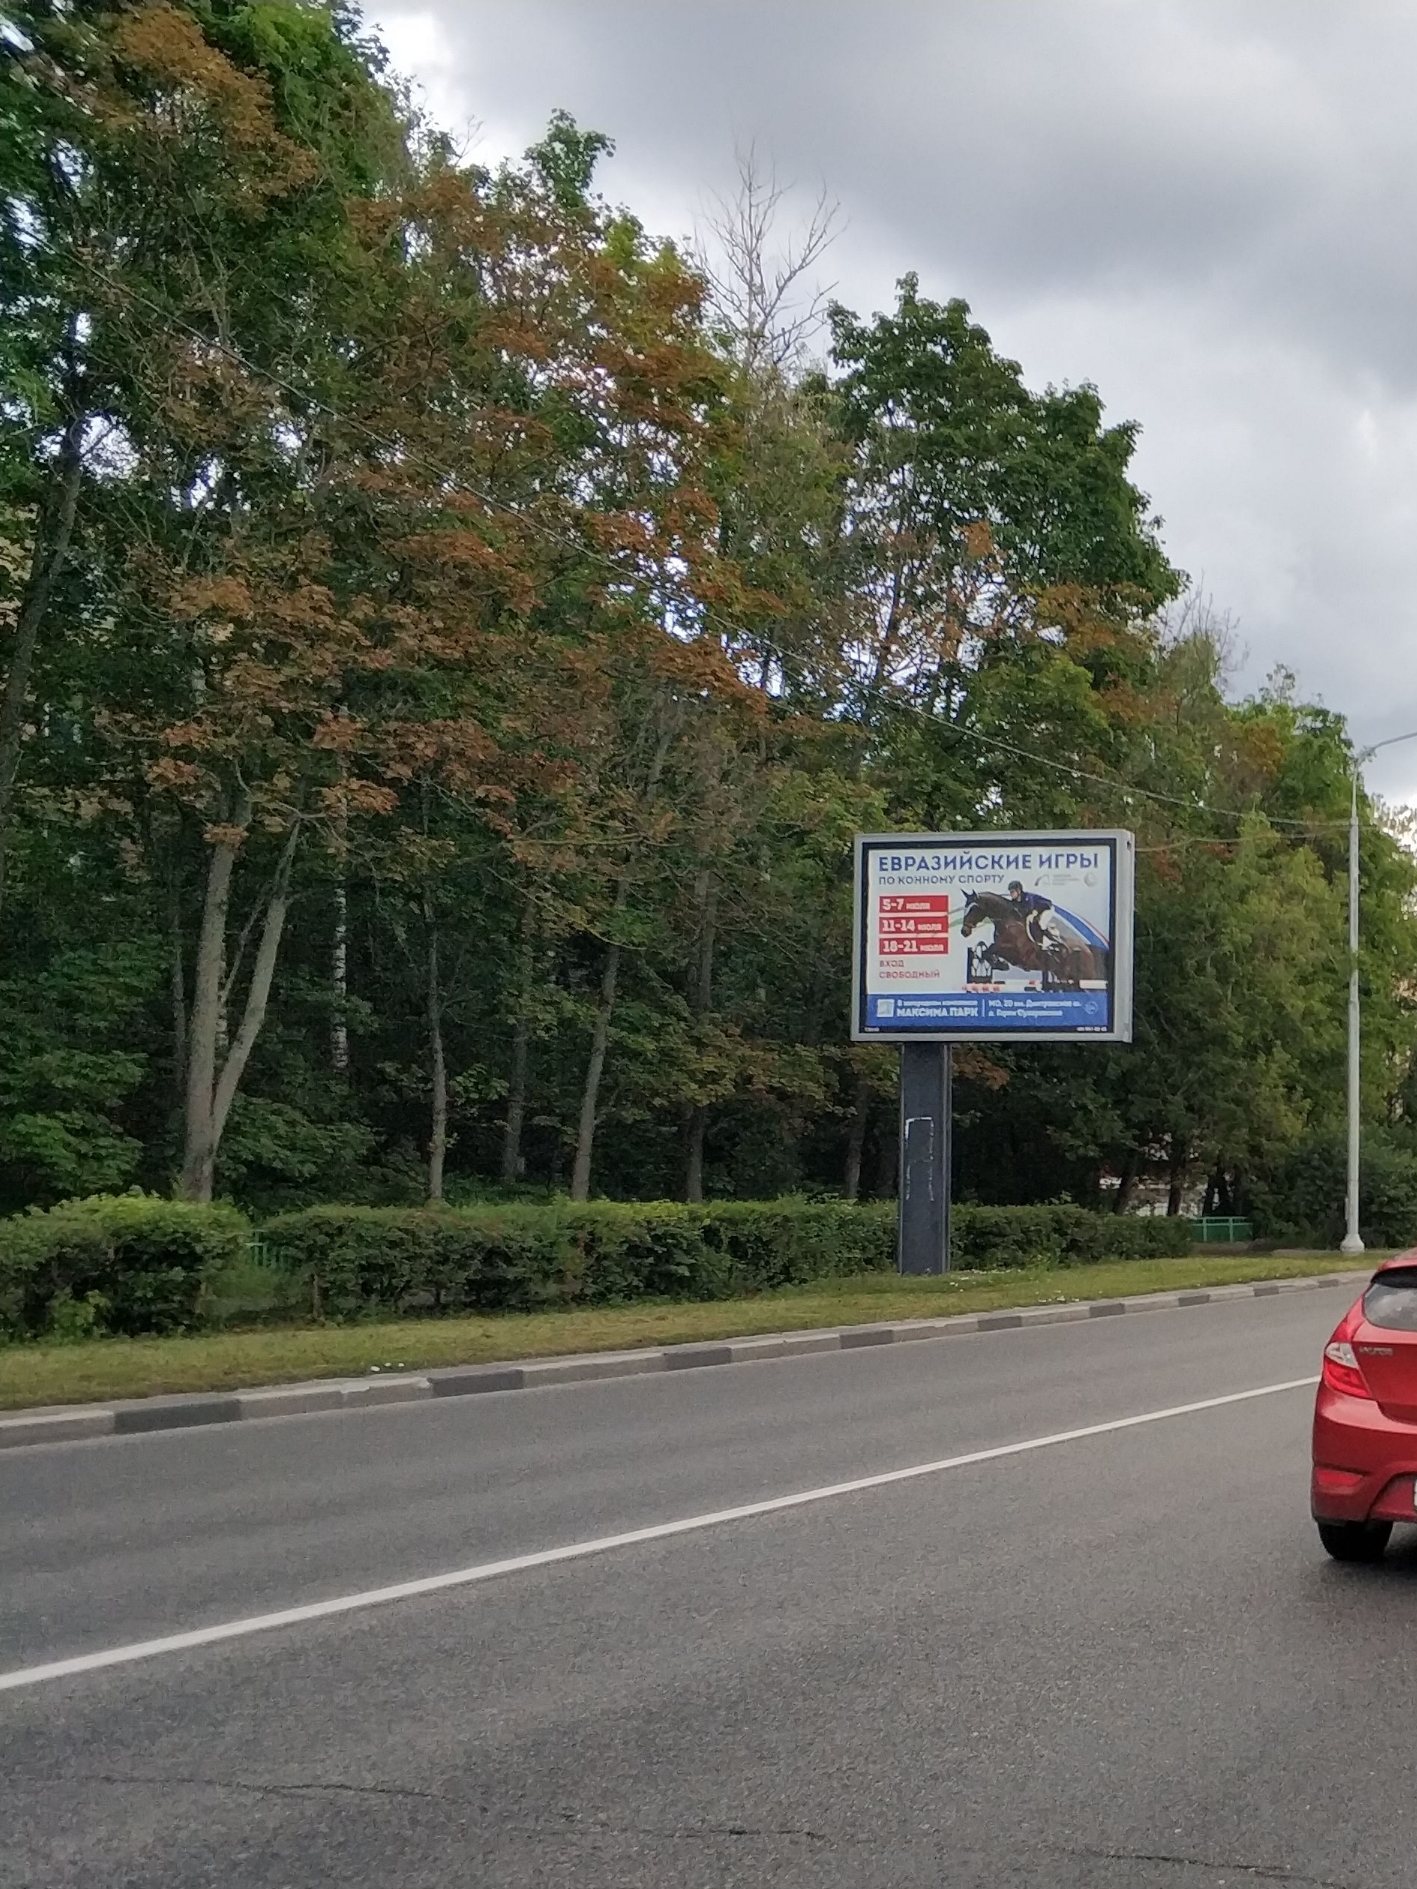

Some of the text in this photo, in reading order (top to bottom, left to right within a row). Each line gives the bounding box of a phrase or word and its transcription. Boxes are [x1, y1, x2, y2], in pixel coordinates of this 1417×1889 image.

[879, 851, 1098, 871] ЕВРАЗИЙСКИЕ ИГРЫ
[879, 874, 1004, 885] ПО КОННОМУ СПОРТУ
[882, 898, 905, 911] 5-7
[882, 919, 916, 931] 11-14
[883, 940, 918, 952] 18-21
[880, 960, 905, 968] ВХОД
[879, 968, 940, 979] СВОБОДНЫЙ
[897, 1007, 947, 1017] МАКСИМА
[949, 1007, 978, 1017] ПАРК
